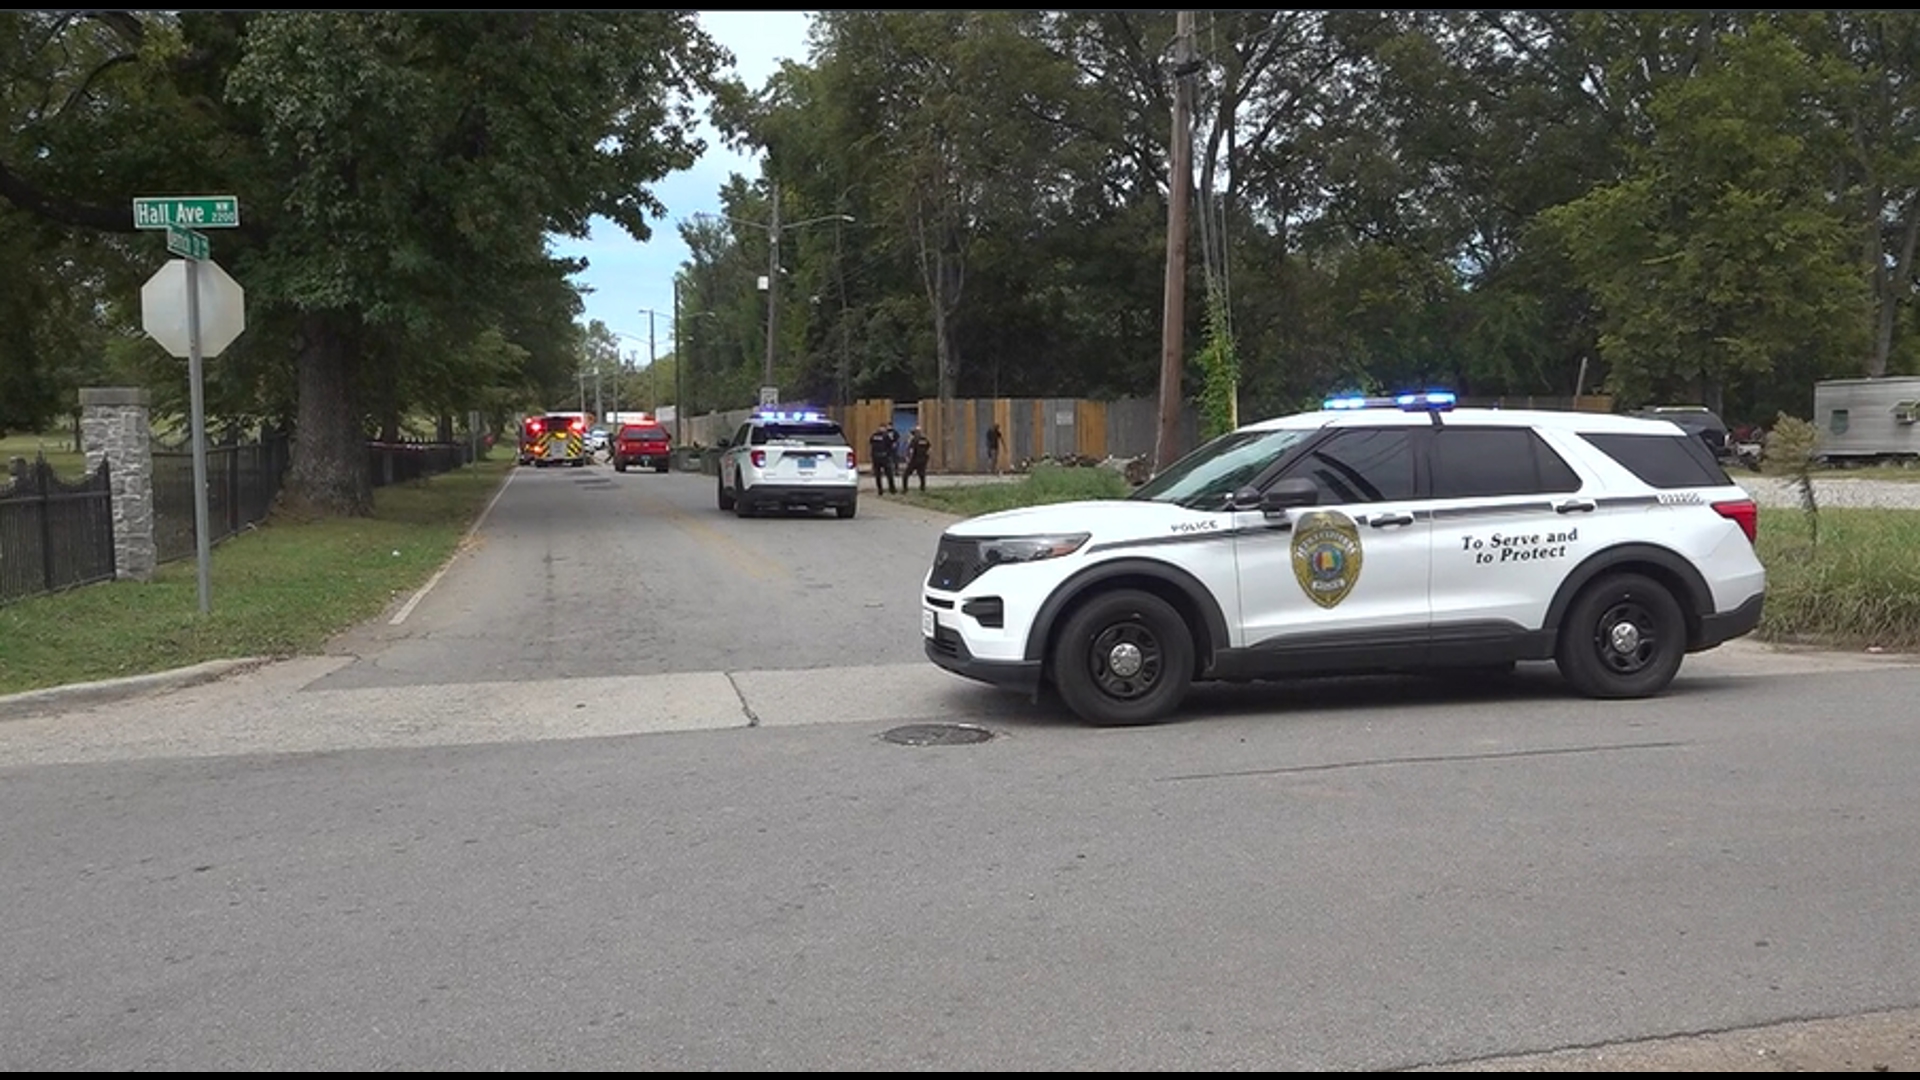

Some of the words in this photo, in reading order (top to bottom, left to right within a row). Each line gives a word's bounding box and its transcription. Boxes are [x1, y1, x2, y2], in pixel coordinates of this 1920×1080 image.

[138, 203, 169, 224] Hall
[176, 202, 204, 223] Ave
[215, 202, 229, 211] NW
[211, 211, 235, 222] 2200
[1170, 520, 1218, 533] POLICE
[1462, 535, 1484, 550] To
[1490, 532, 1541, 549] Serve
[1546, 527, 1578, 543] and
[1475, 552, 1494, 564] to
[1500, 545, 1566, 562] Protect
